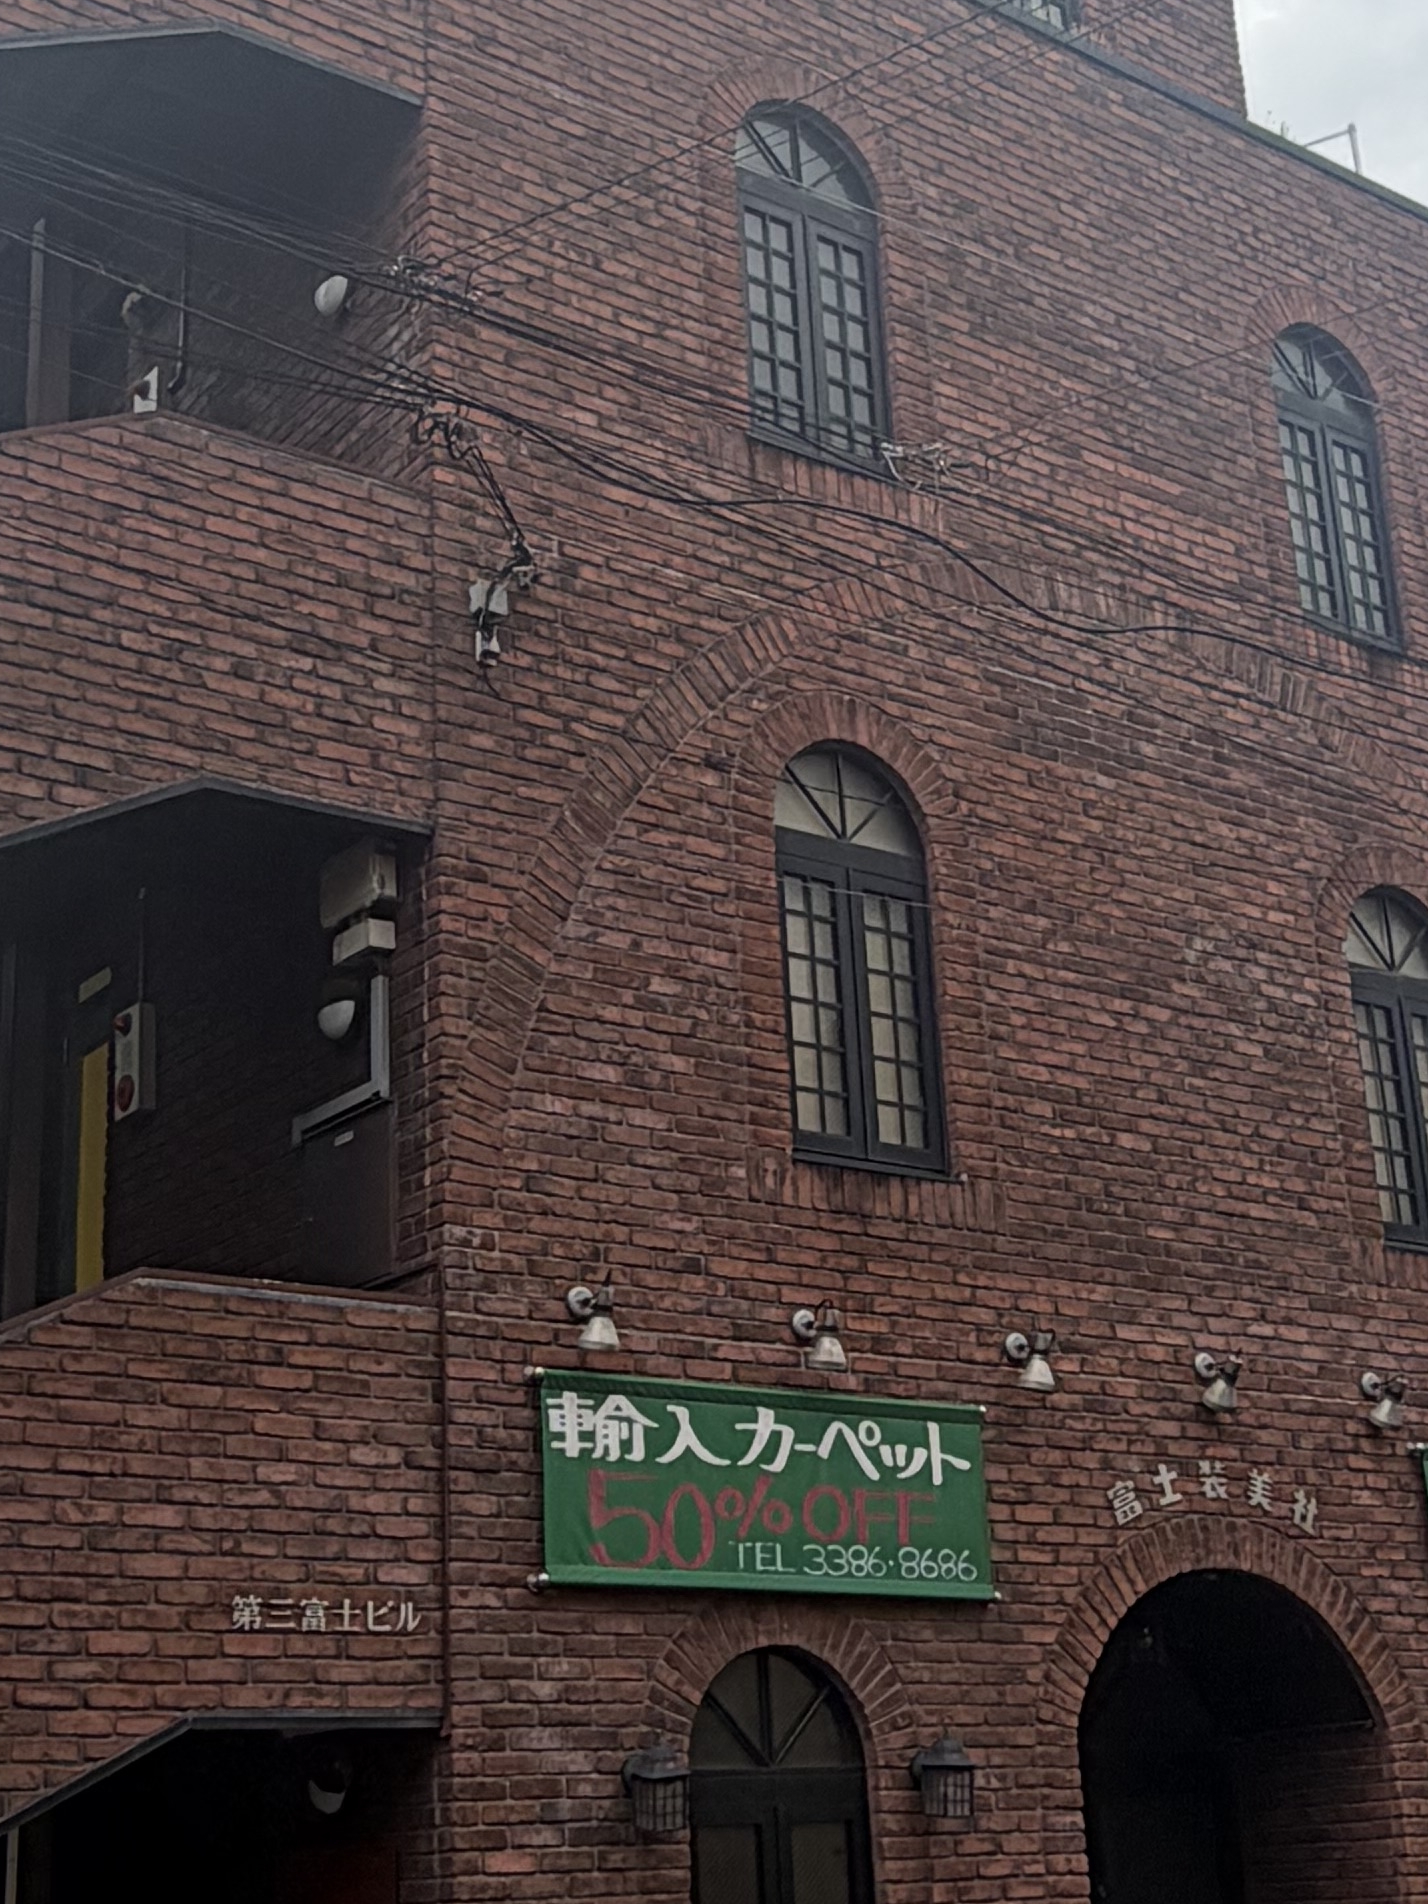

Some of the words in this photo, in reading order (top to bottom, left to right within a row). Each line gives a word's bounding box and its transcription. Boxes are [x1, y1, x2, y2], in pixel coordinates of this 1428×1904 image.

[728, 1541, 796, 1574] TEL
[231, 1594, 422, 1633] 第三富士ビル
